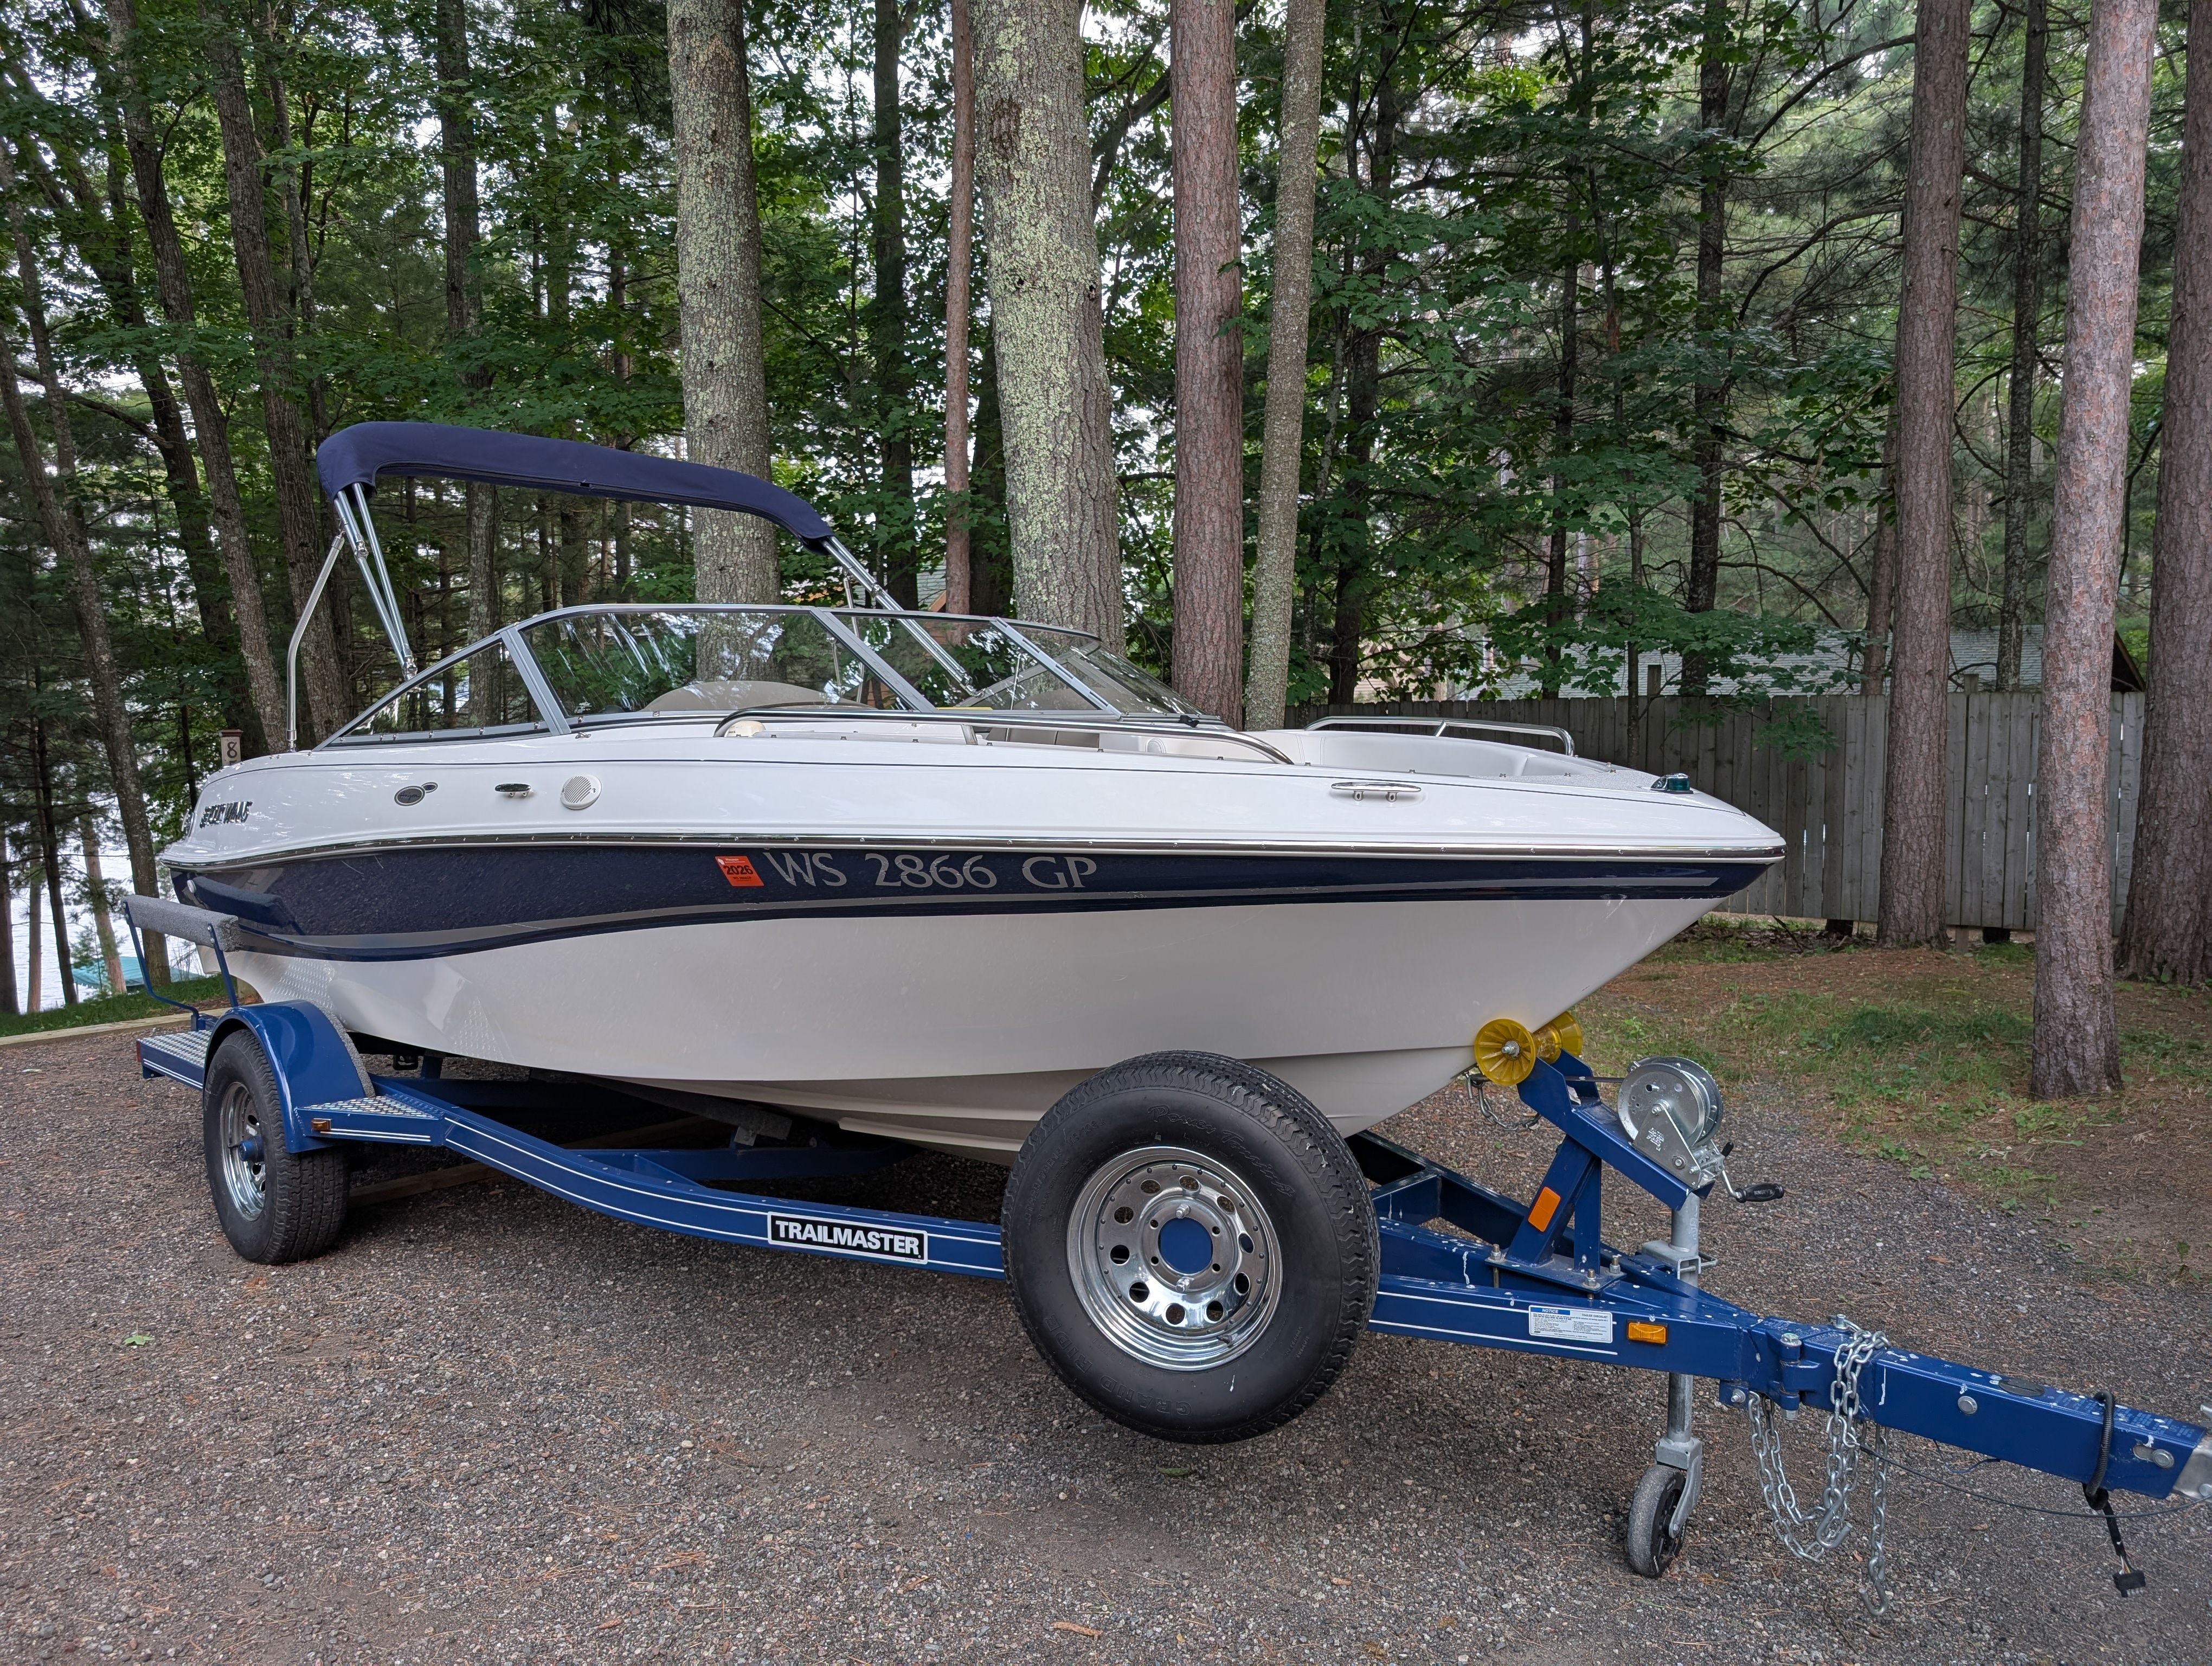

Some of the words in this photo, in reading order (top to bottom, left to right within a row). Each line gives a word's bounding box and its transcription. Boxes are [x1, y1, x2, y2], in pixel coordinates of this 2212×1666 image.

[227, 741, 237, 766] 8
[723, 865, 754, 875] 2026
[763, 852, 847, 887] WS
[864, 853, 997, 888] 2866
[1022, 856, 1097, 888] GP
[775, 1220, 919, 1255] TRAILMASTER
[1045, 1313, 1092, 1374] RIDE
[1099, 1375, 1192, 1415] GRAND
